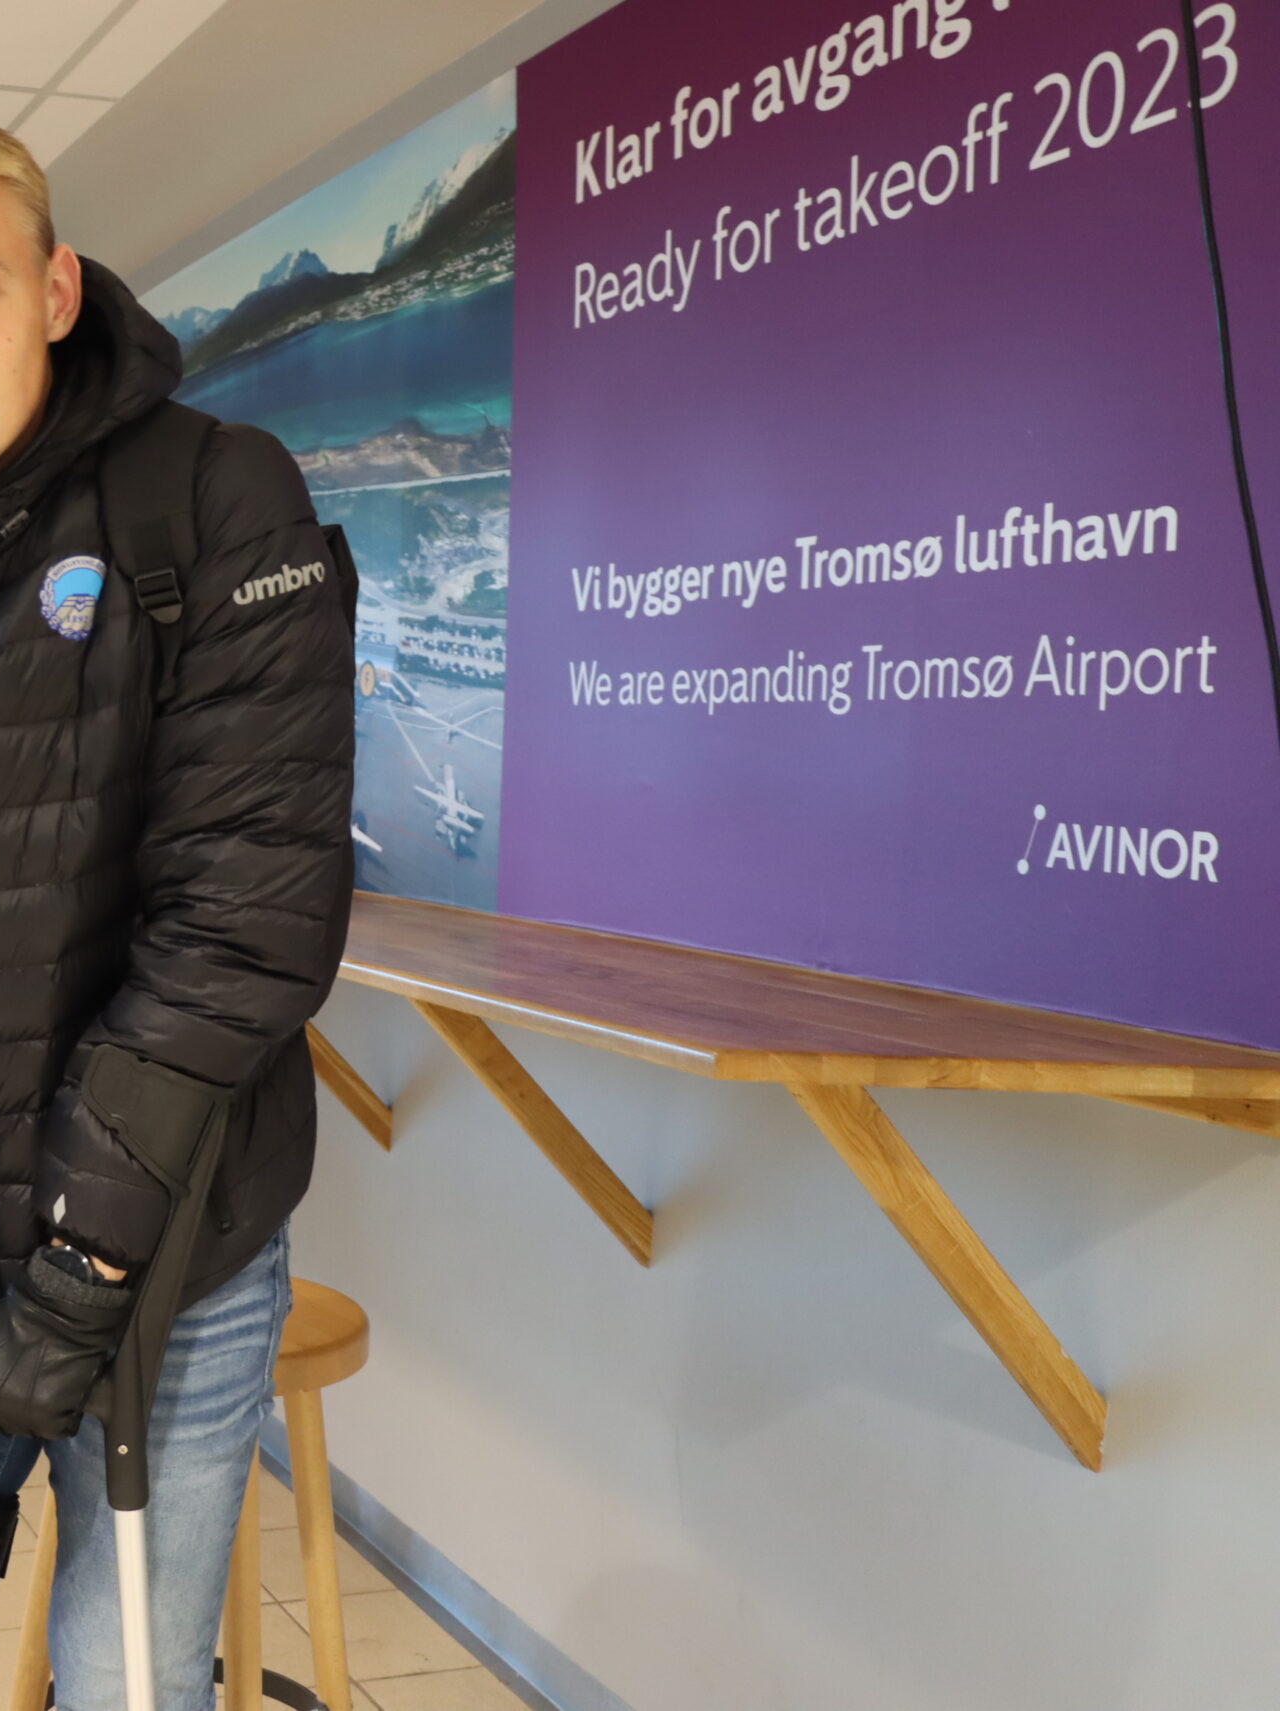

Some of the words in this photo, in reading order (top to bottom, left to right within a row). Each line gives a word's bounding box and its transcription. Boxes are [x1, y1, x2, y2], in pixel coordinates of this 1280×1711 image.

[574, 127, 661, 203] Klar
[671, 86, 740, 159] for
[752, 0, 972, 111] avgang
[574, 230, 701, 328] Ready
[713, 206, 781, 280] for
[794, 92, 1013, 251] takeoff
[1028, 3, 1239, 170] 2023
[232, 561, 326, 605] umbro
[571, 565, 602, 612] Vi
[607, 558, 716, 620] bygger
[721, 555, 787, 609] nye
[795, 535, 943, 590] Tromsø
[955, 502, 1179, 574] lufthavn
[569, 660, 613, 707] We
[618, 670, 665, 706] are
[671, 649, 853, 717] expanding
[861, 644, 1013, 701] Tromsø
[1024, 634, 1218, 711] Airport
[1045, 822, 1220, 883] AVINOR
